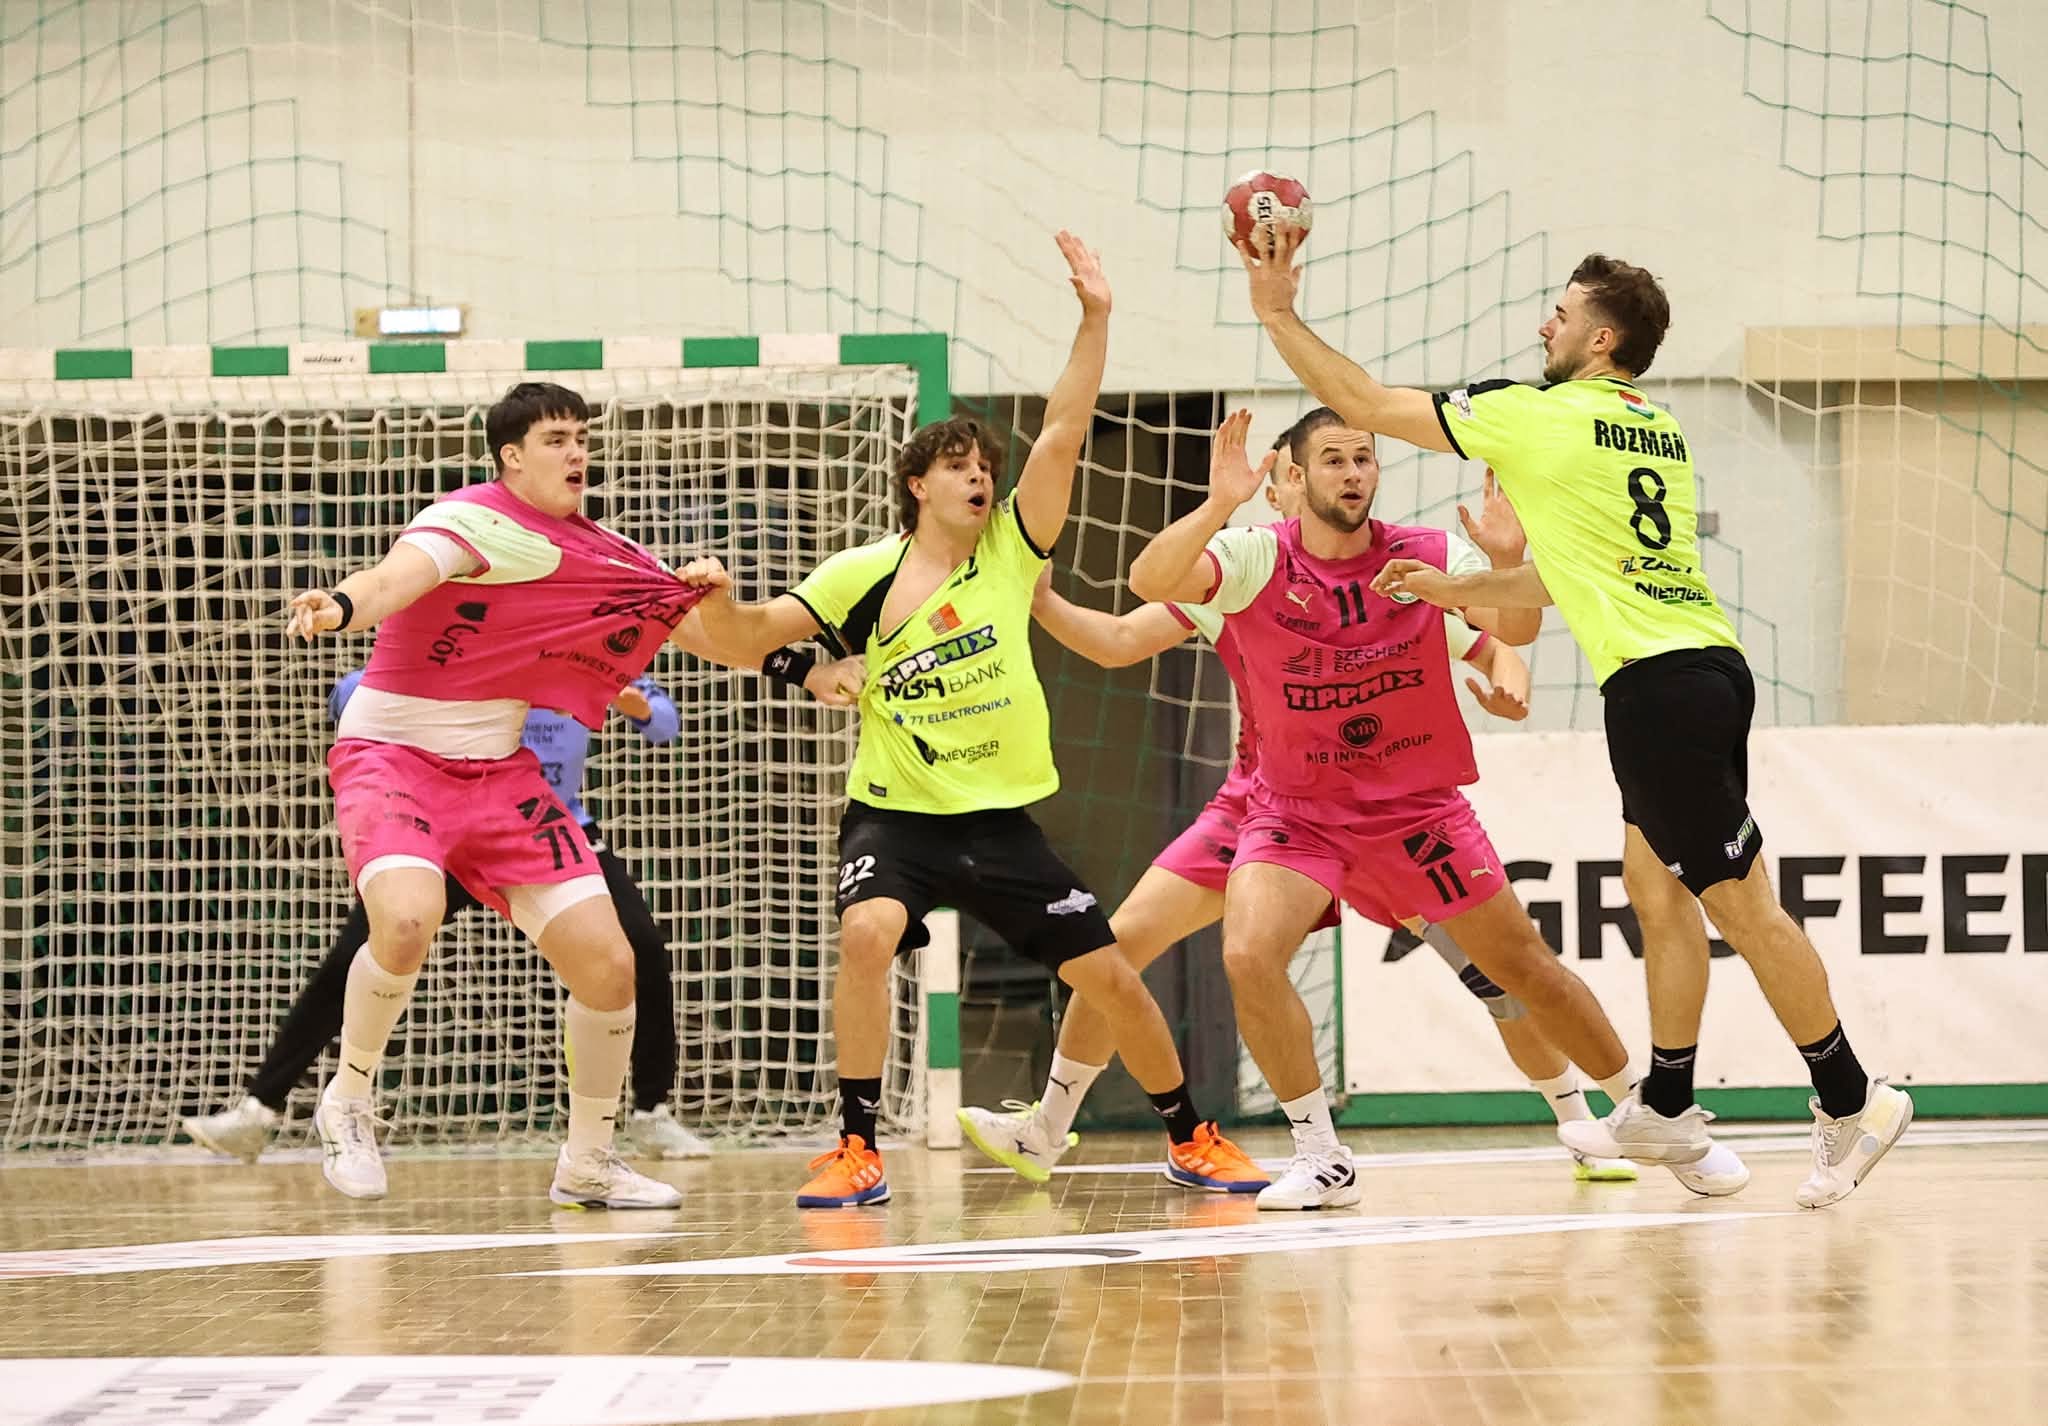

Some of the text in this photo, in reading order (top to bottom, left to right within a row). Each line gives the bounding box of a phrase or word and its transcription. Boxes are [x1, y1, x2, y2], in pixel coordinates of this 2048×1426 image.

[1594, 418, 1687, 462] ROZMAN
[1627, 467, 1671, 550] 8
[1333, 580, 1368, 629] 11
[949, 660, 1007, 693] BANK
[909, 697, 1013, 725] 77 ELEKTRONIKA
[1384, 733, 1433, 757] GROUP
[839, 854, 877, 892] 22
[1425, 860, 1469, 905] 11
[1382, 855, 2048, 963] GRFEE
